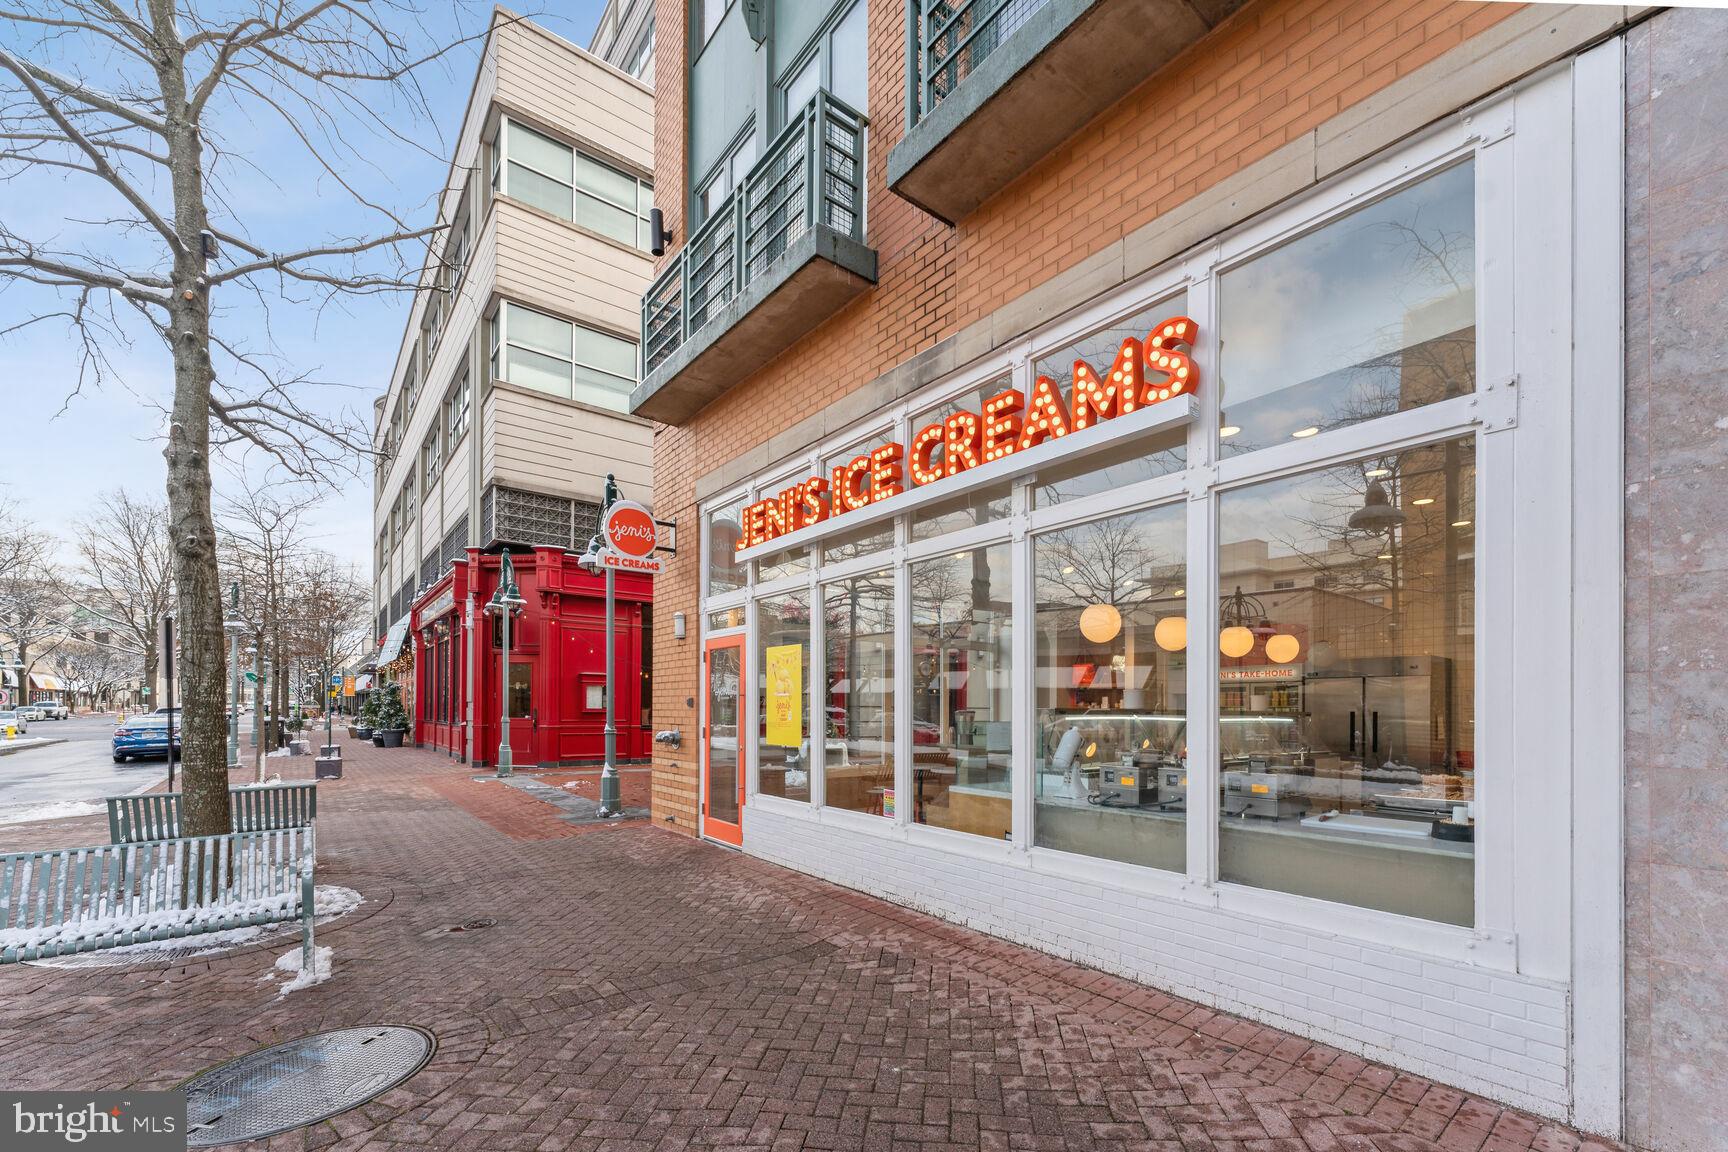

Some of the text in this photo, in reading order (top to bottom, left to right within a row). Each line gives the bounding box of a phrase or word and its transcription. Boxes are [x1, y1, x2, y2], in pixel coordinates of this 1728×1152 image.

[736, 316, 1200, 551] JENI'S ICE CREAMS
[609, 520, 655, 542] jeni's
[604, 555, 660, 571] ICE CREAMS
[1220, 669, 1293, 679] NI'S TAKE-HOME
